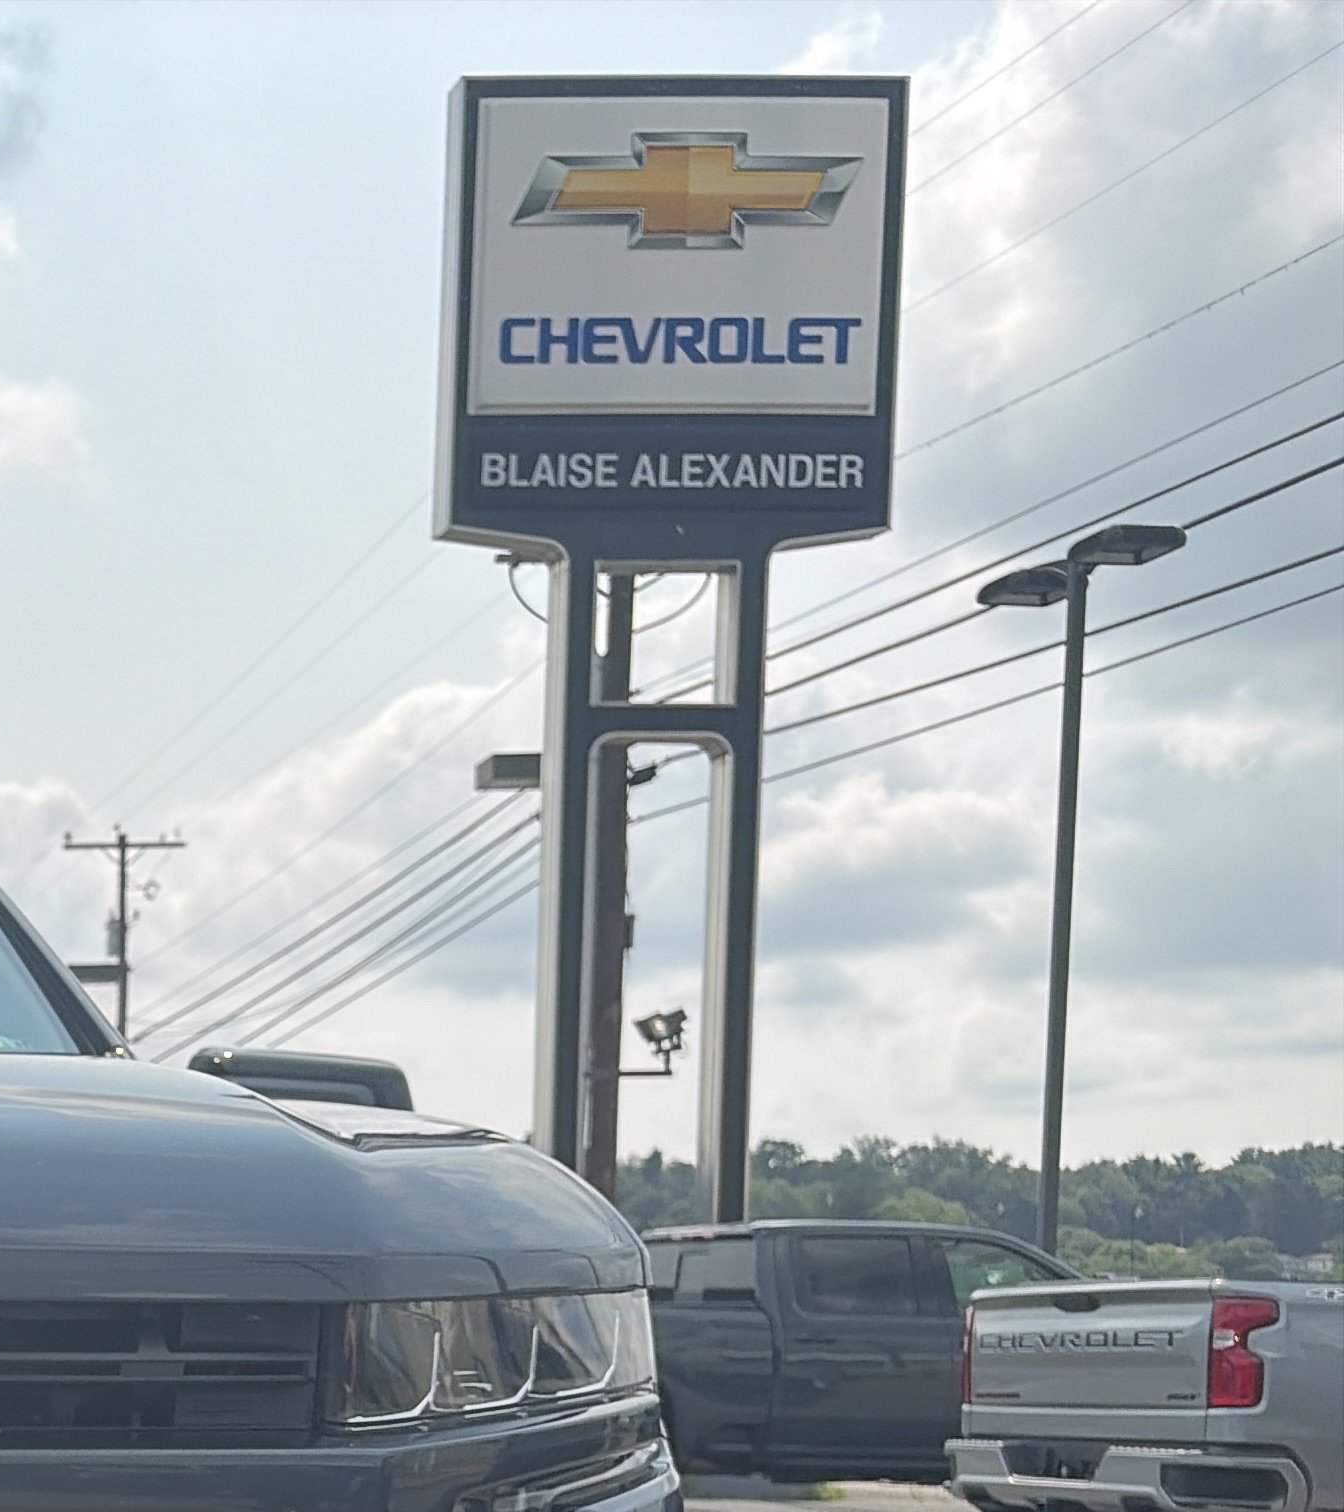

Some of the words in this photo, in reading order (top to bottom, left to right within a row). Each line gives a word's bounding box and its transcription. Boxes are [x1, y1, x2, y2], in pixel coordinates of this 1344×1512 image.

[499, 316, 861, 365] CHEVROLET
[480, 453, 618, 488] BLAISE
[629, 454, 863, 489] ALEXANDER
[979, 1329, 1184, 1349] CHEVROLET
